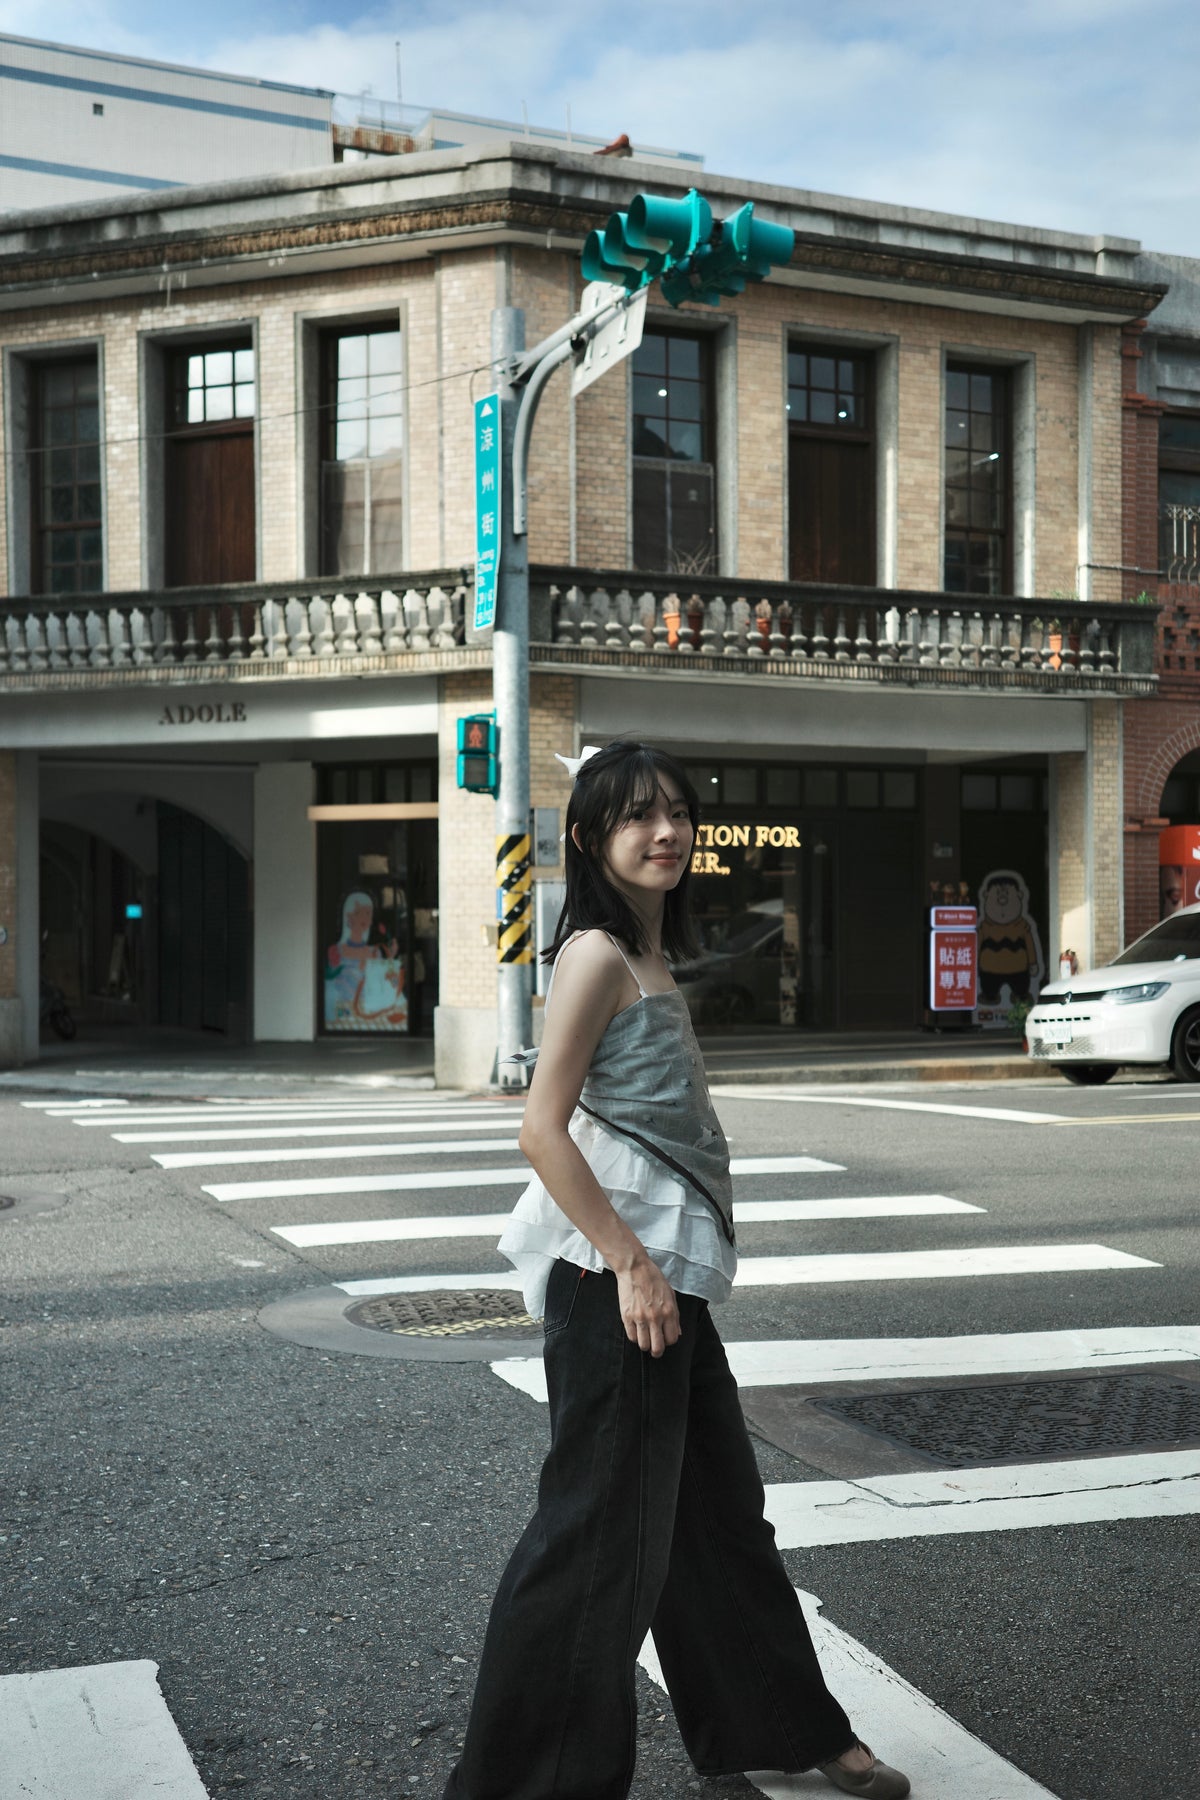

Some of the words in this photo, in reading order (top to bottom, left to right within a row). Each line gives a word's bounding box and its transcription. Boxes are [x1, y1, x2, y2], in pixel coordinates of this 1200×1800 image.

[159, 702, 247, 725] ADOLE
[755, 826, 801, 848] FOR
[940, 947, 972, 966] 貼紙
[939, 970, 971, 989] 專賣
